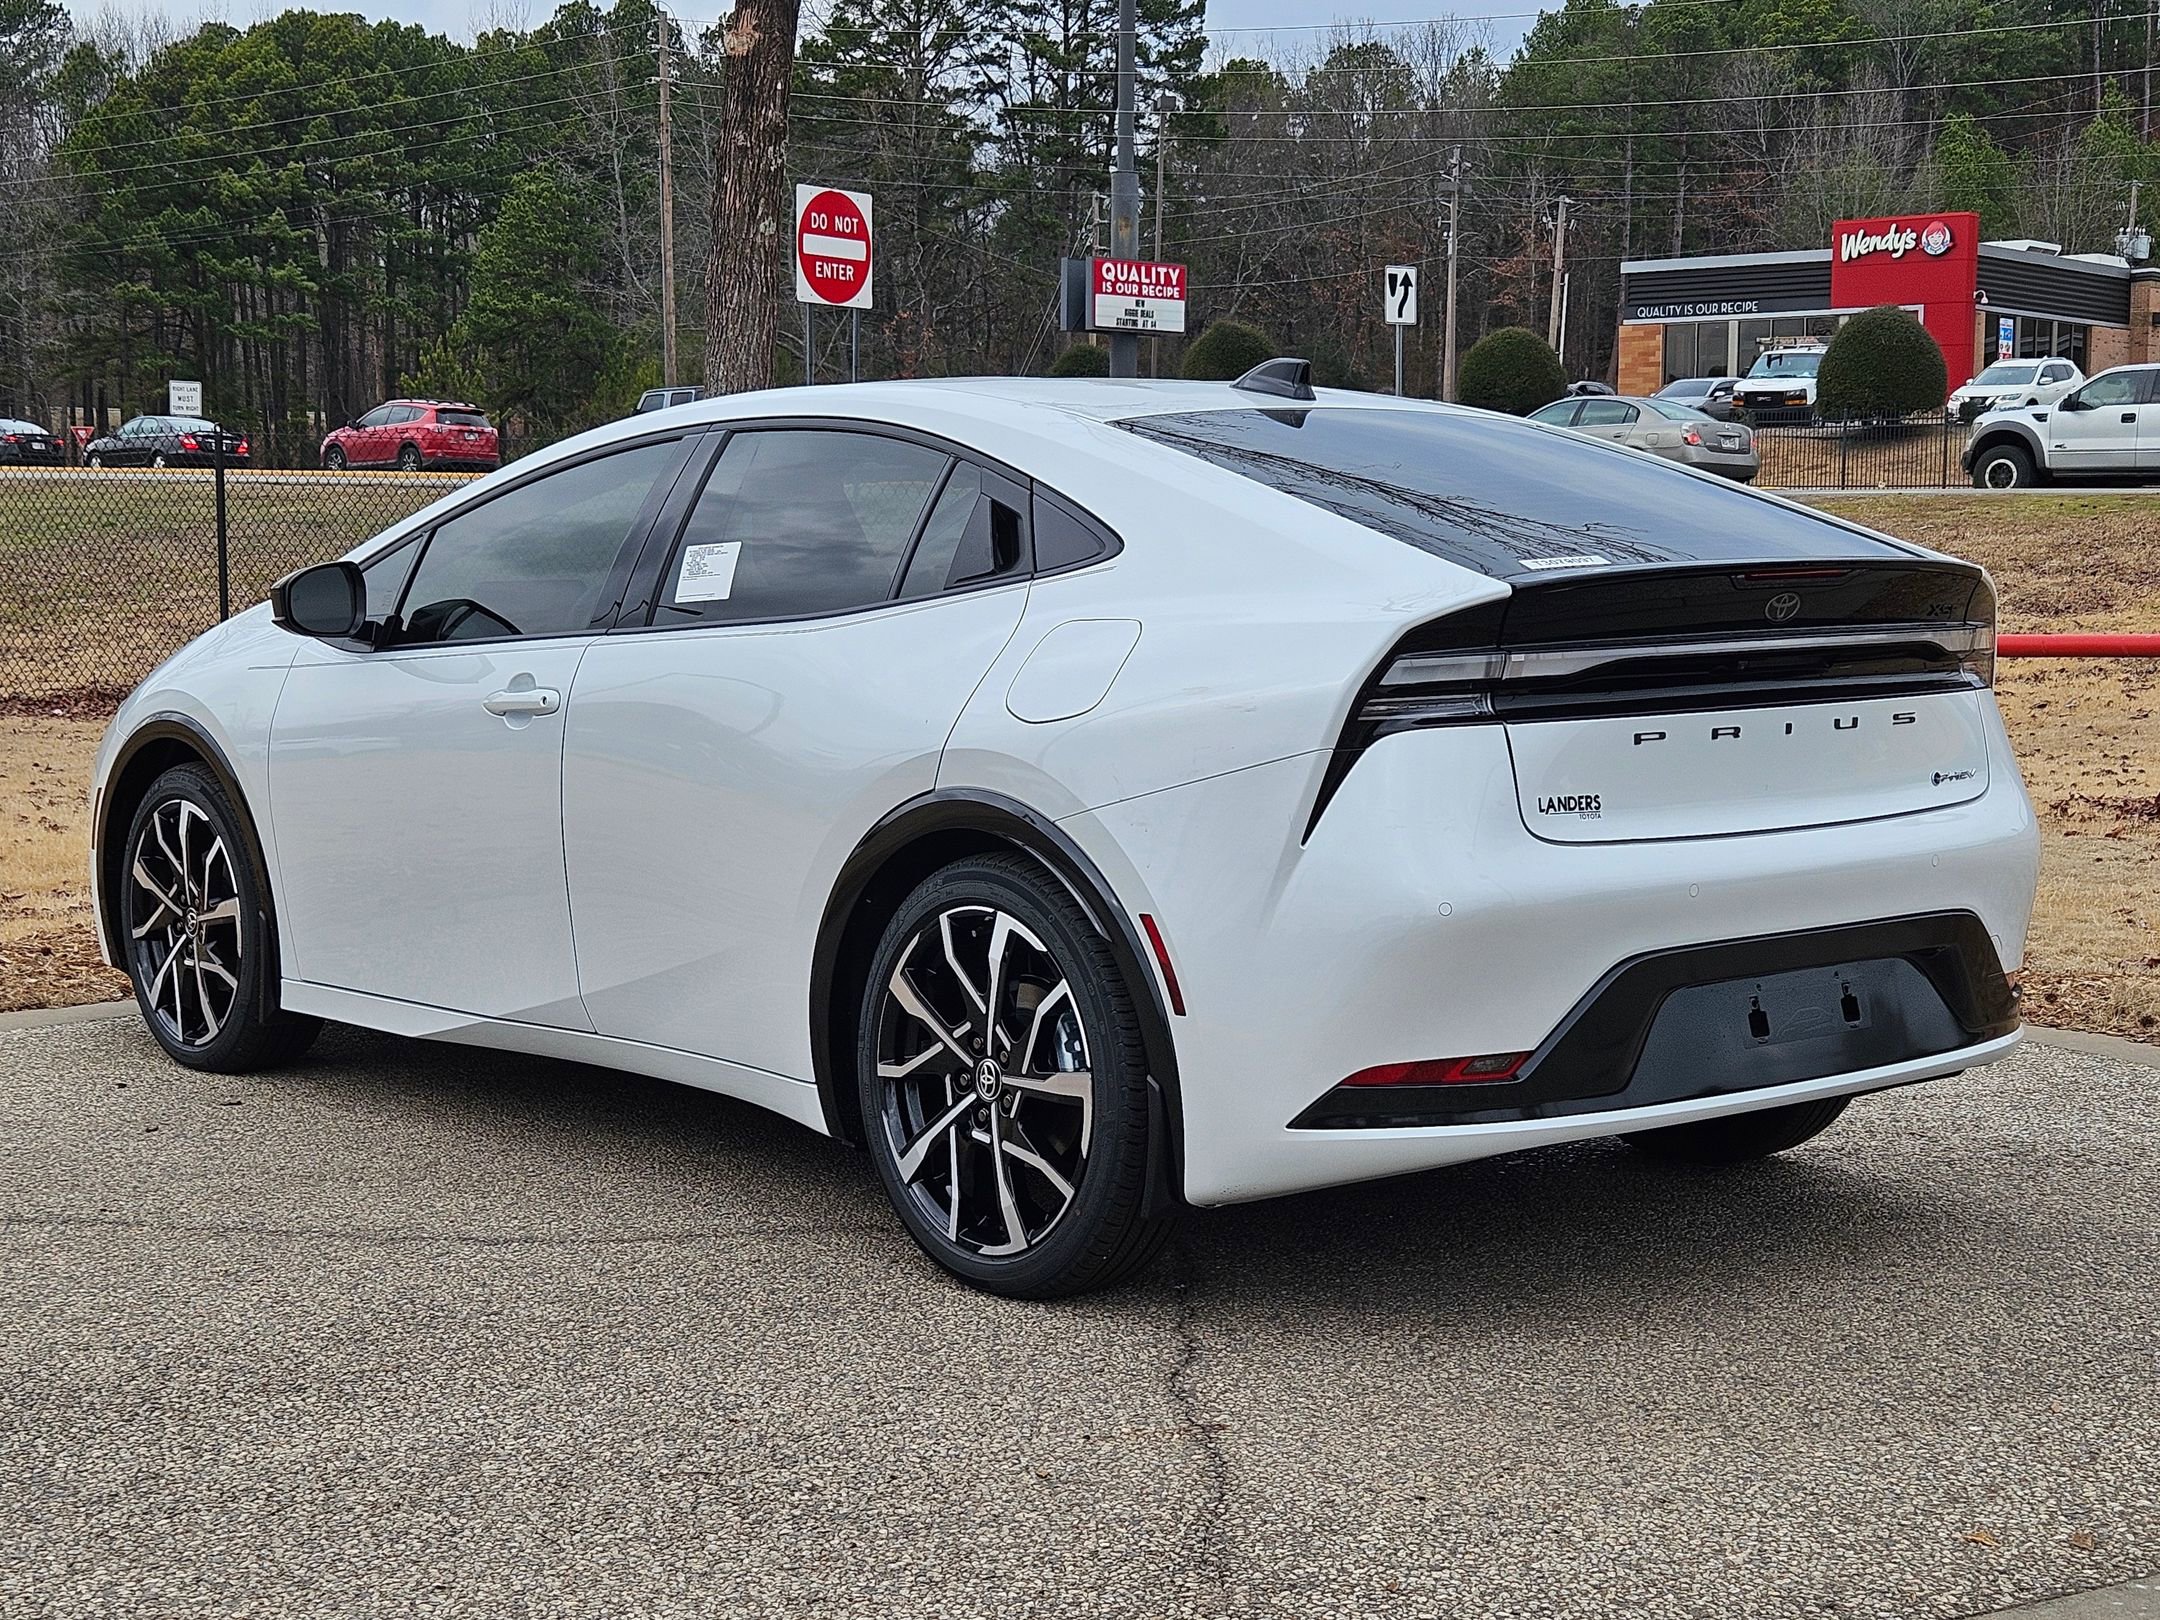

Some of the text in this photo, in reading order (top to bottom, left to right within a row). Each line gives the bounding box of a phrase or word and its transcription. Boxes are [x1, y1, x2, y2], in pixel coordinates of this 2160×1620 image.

[811, 212, 859, 234] DO NOT
[1841, 223, 1917, 262] Wendy's
[815, 261, 854, 281] ENTER
[1102, 262, 1180, 285] QUALITY
[1102, 281, 1180, 298] IS OUR RECIPE
[1637, 301, 1759, 318] QUALITY IS OUR RECIPE
[1633, 711, 1916, 746] PRIUS
[1538, 794, 1601, 815] LANDERS
